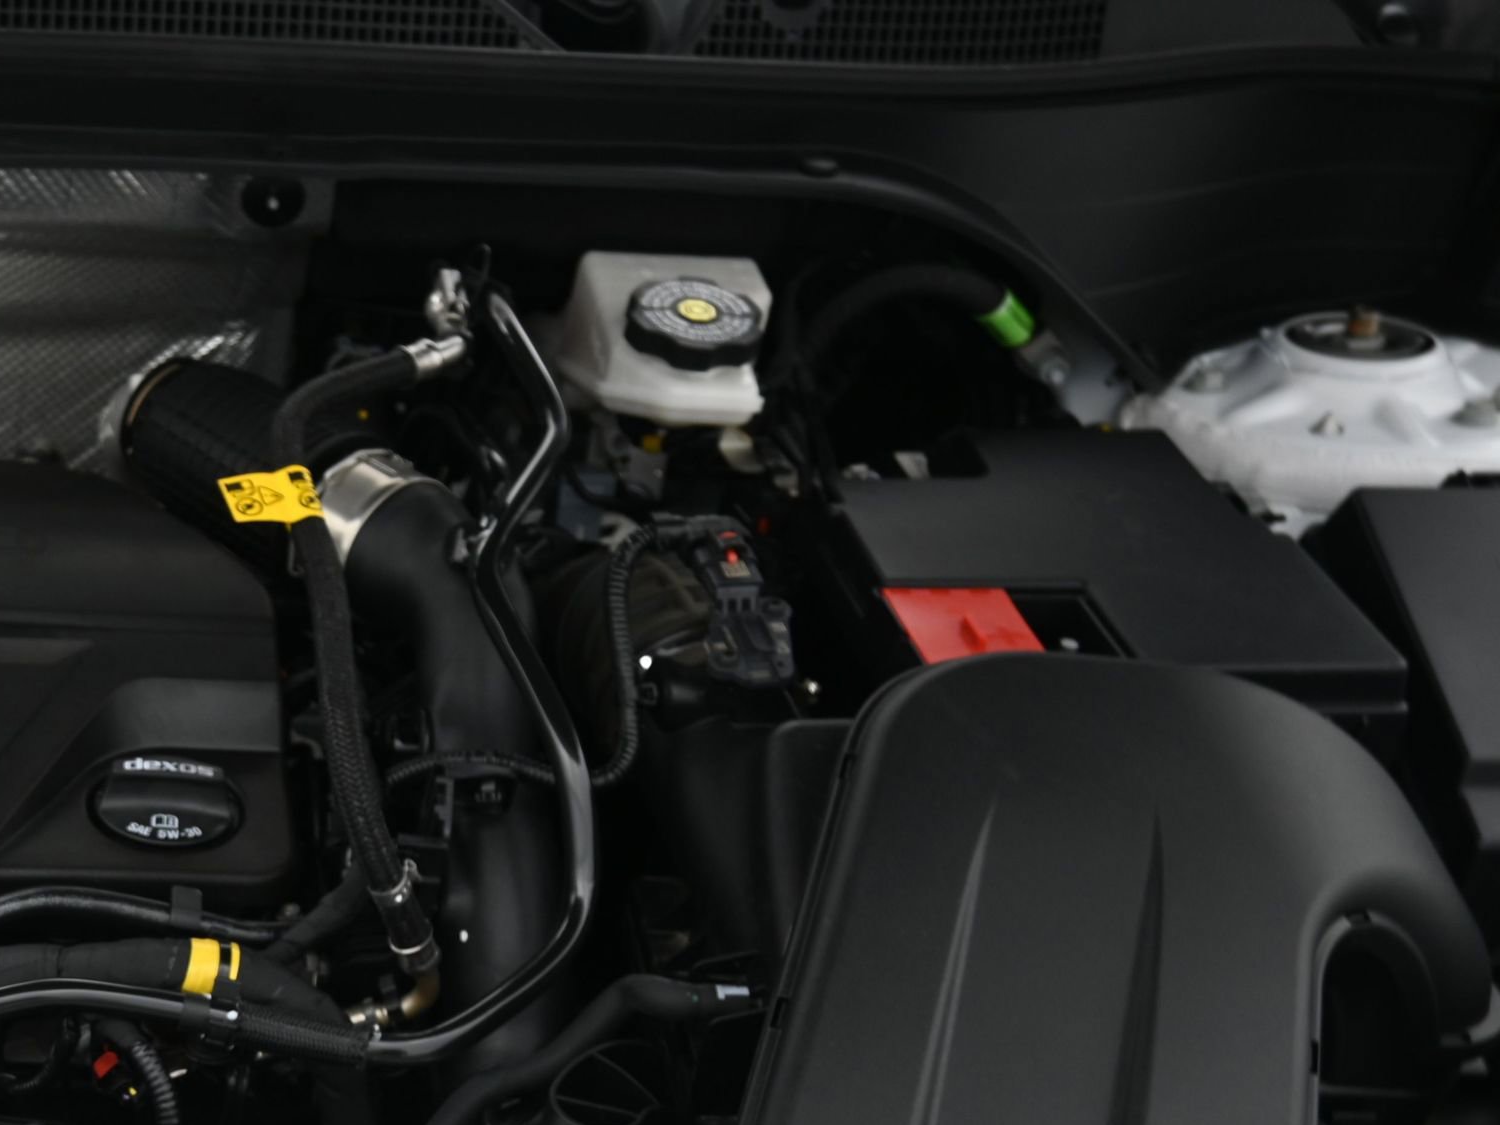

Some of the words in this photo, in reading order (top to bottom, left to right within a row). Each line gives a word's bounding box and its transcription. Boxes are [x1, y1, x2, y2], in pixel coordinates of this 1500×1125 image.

[123, 757, 214, 778] dexos
[126, 822, 153, 837] SAE
[157, 826, 202, 839] 5W-30
